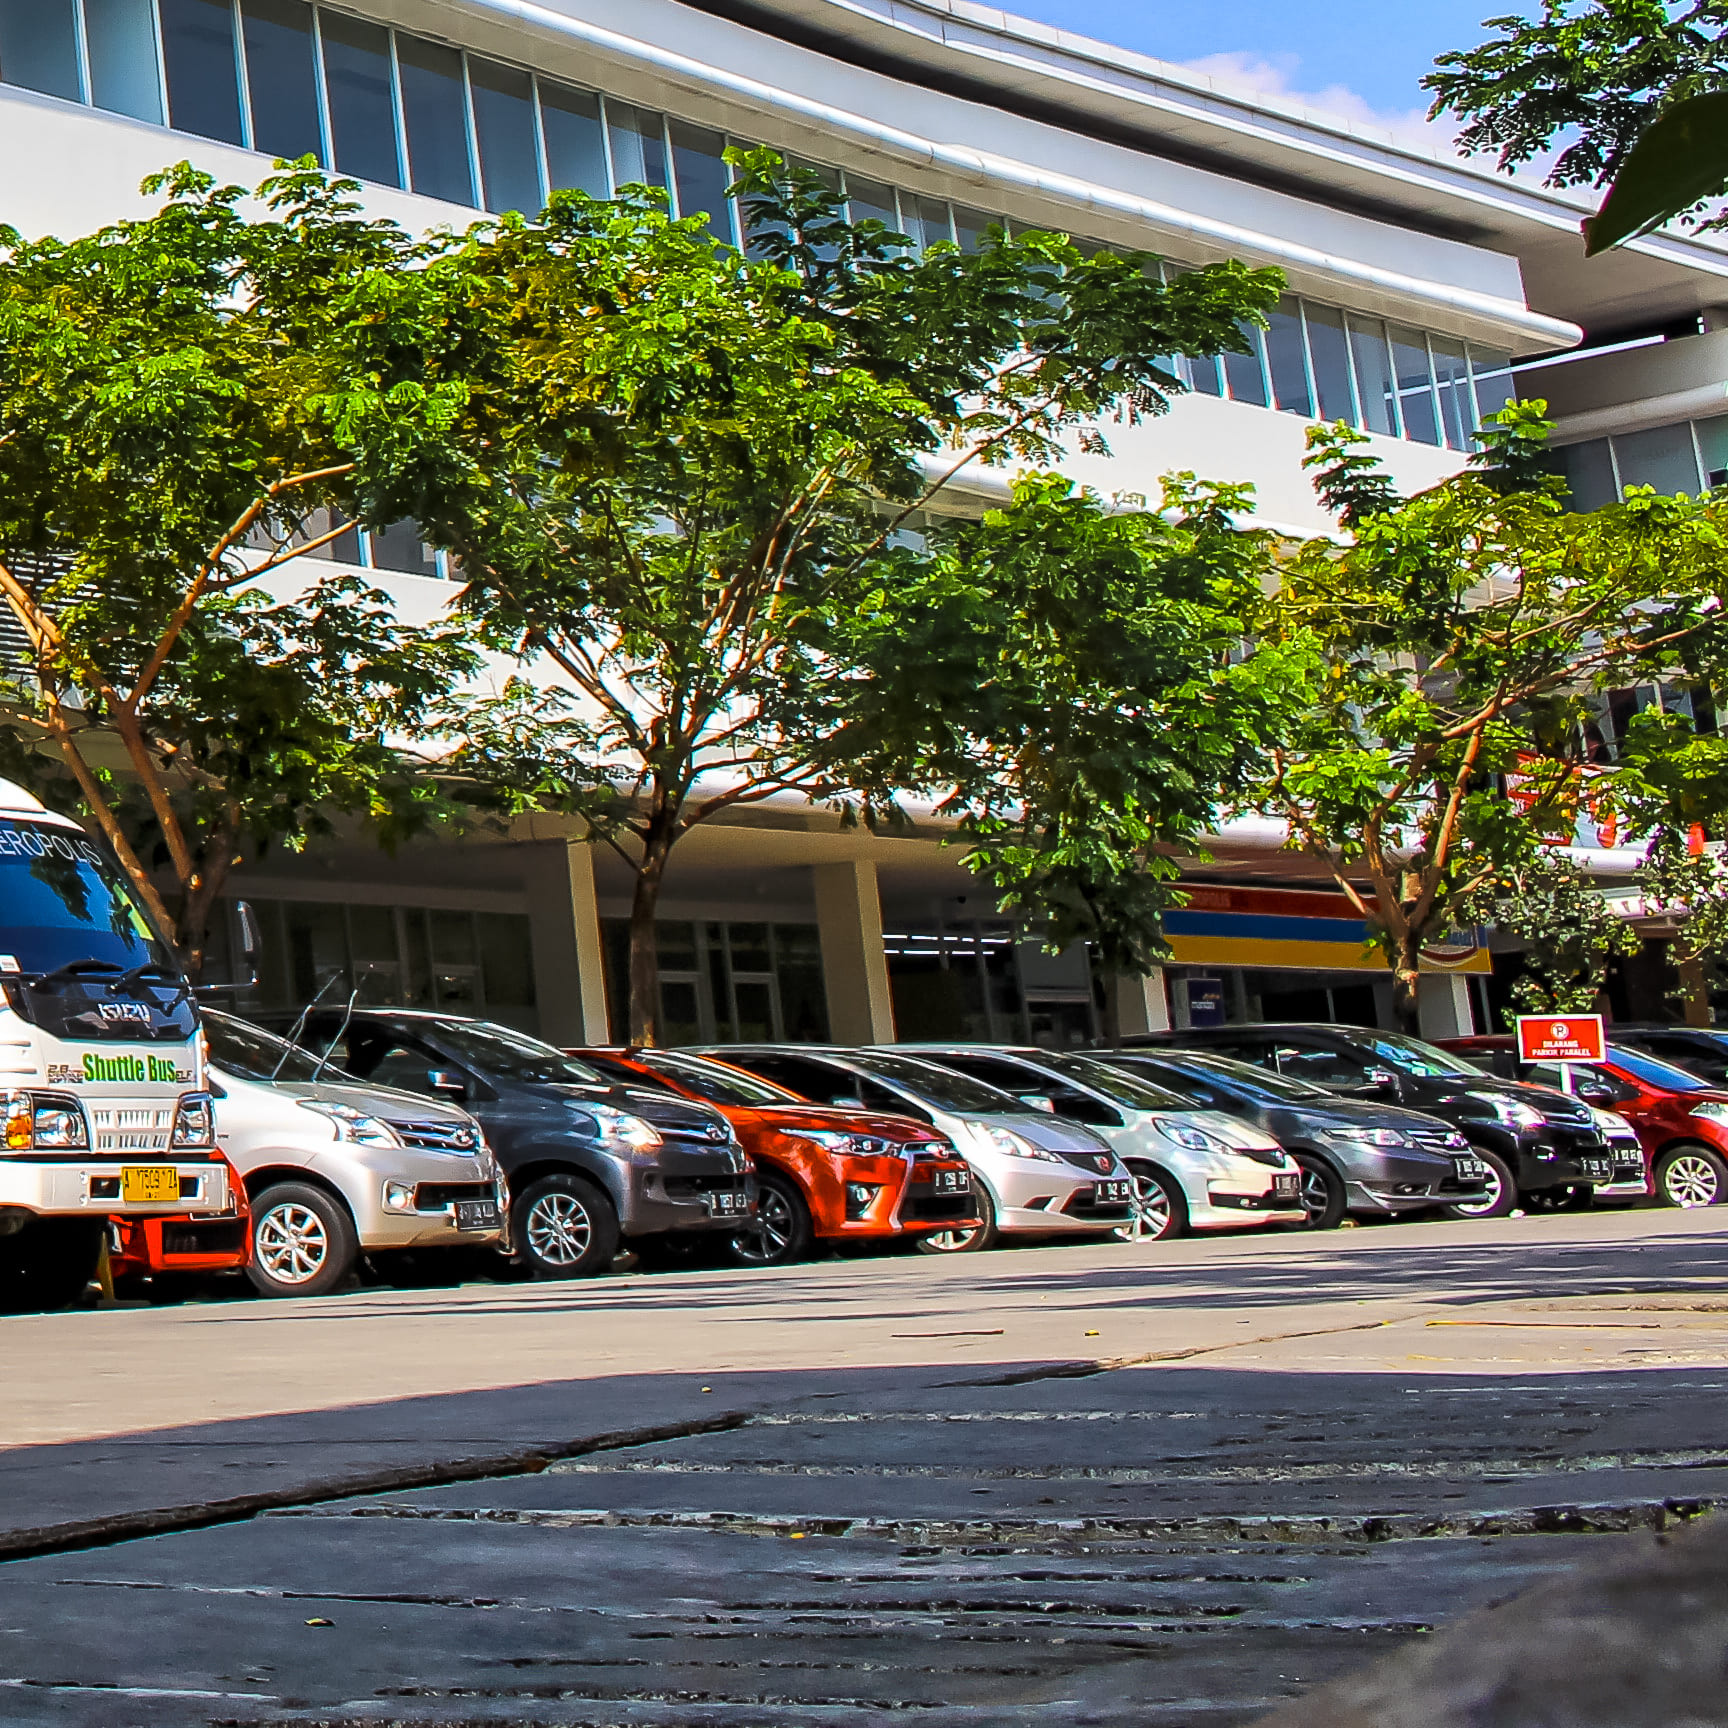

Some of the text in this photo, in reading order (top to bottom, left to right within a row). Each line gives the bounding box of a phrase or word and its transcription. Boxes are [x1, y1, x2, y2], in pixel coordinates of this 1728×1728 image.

[97, 1003, 151, 1022] ISUZU
[82, 1053, 177, 1082] Shuttle Bus
